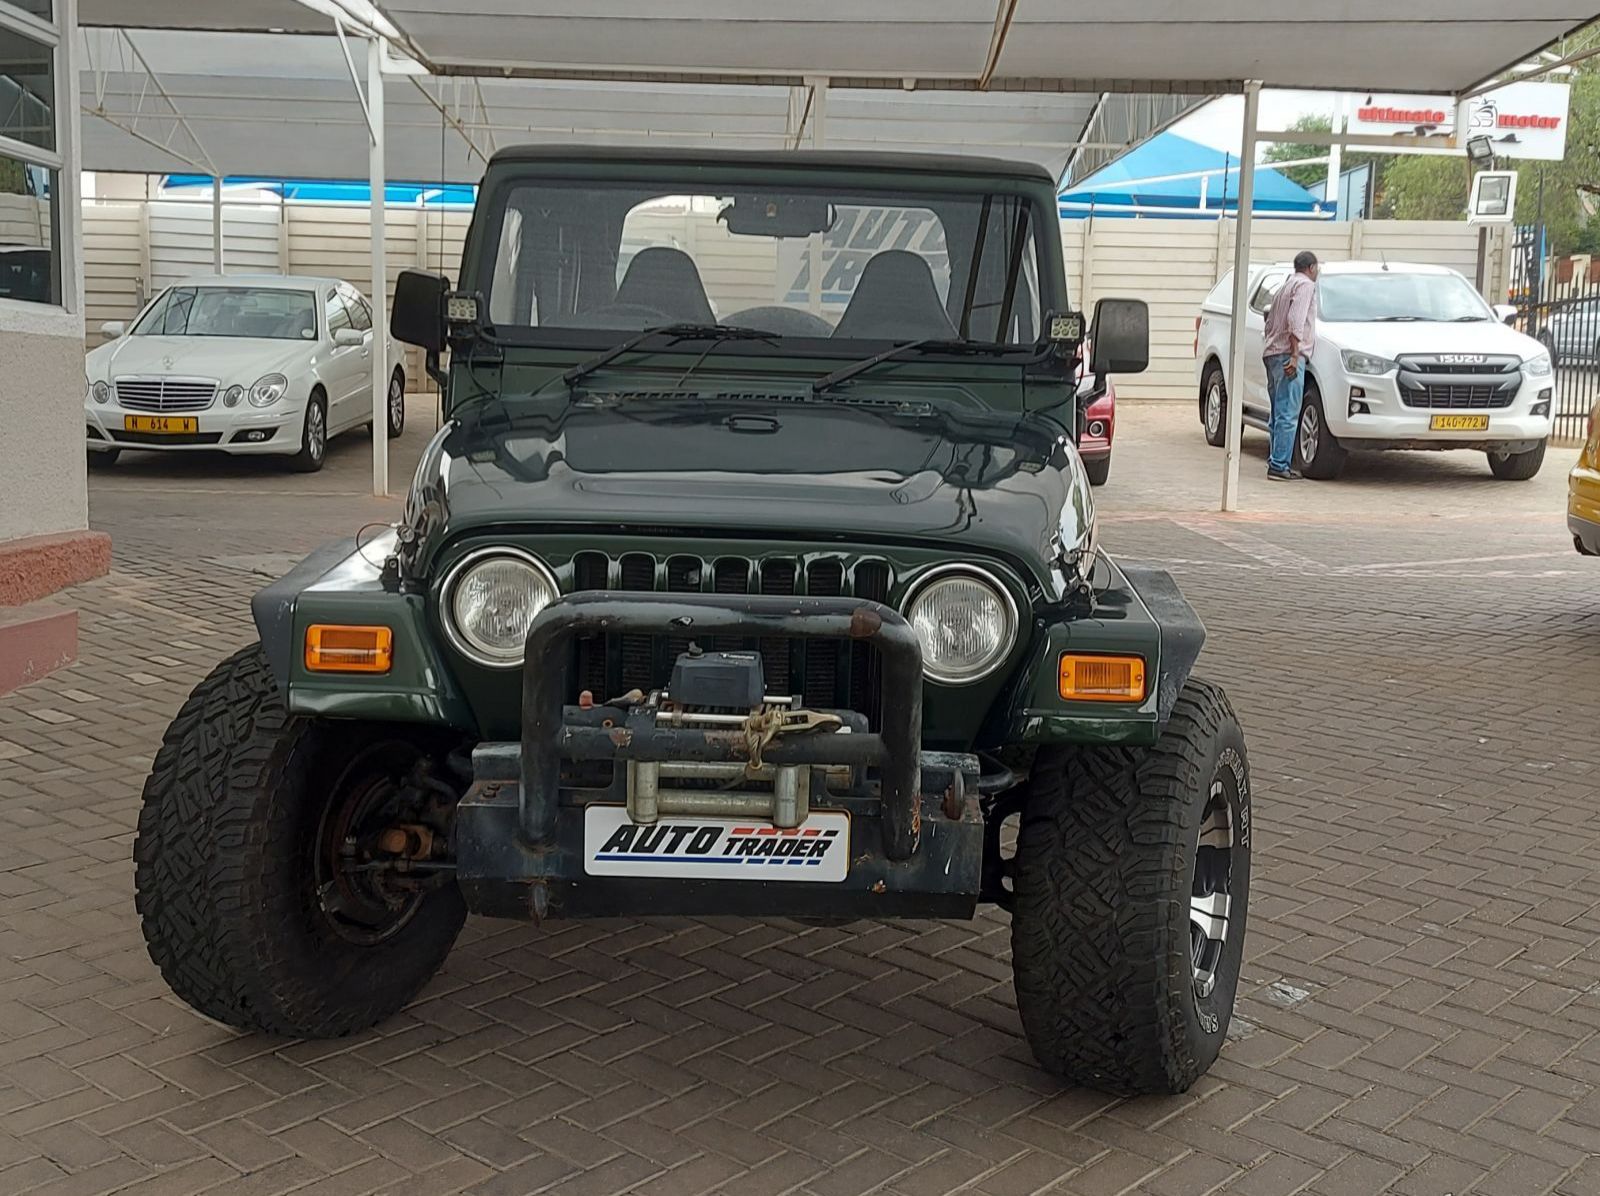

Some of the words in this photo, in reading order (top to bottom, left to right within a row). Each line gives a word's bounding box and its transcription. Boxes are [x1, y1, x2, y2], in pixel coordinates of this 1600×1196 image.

[1358, 107, 1445, 123] ultimate
[1499, 113, 1560, 129] motor
[1439, 354, 1484, 363] ISUZU
[150, 419, 168, 430] 614
[599, 824, 725, 855] AUTO
[722, 837, 833, 858] TRADER
